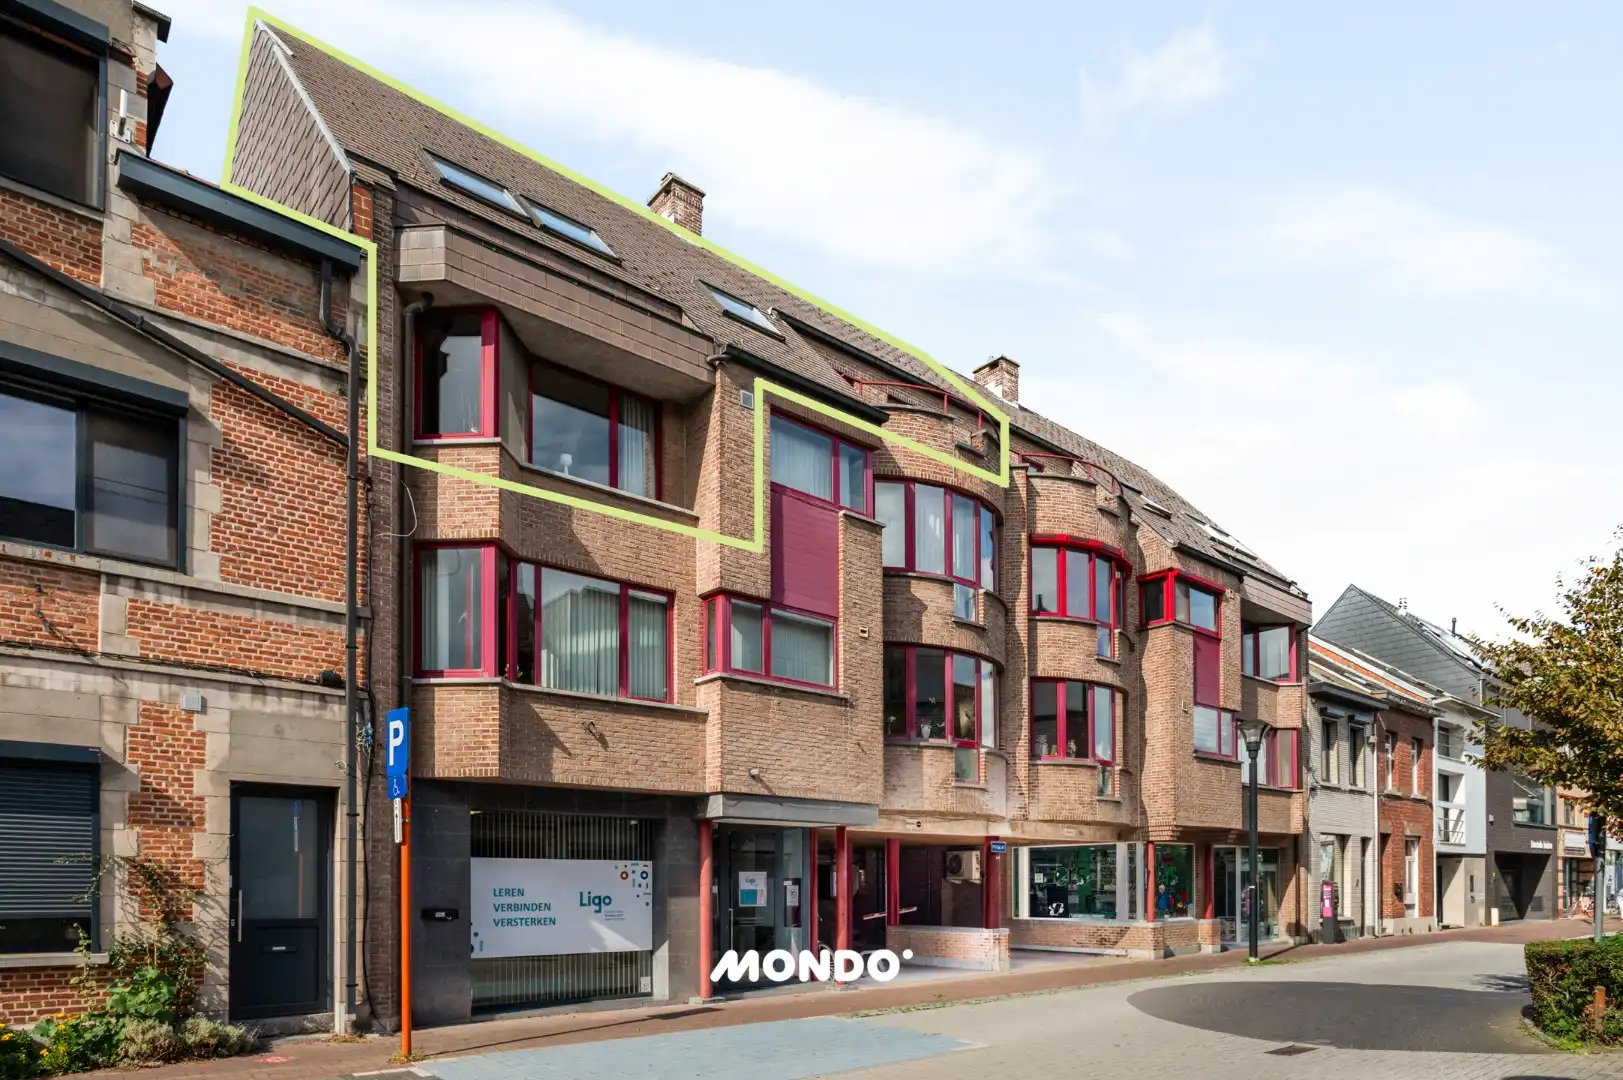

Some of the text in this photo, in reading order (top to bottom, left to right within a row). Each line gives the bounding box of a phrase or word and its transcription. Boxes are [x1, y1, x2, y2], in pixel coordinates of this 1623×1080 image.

[389, 720, 404, 766] P
[493, 888, 525, 897] LEREN
[579, 891, 612, 913] Ligo
[493, 903, 551, 912] VERBINDEN
[493, 917, 556, 927] VERSTERKEN
